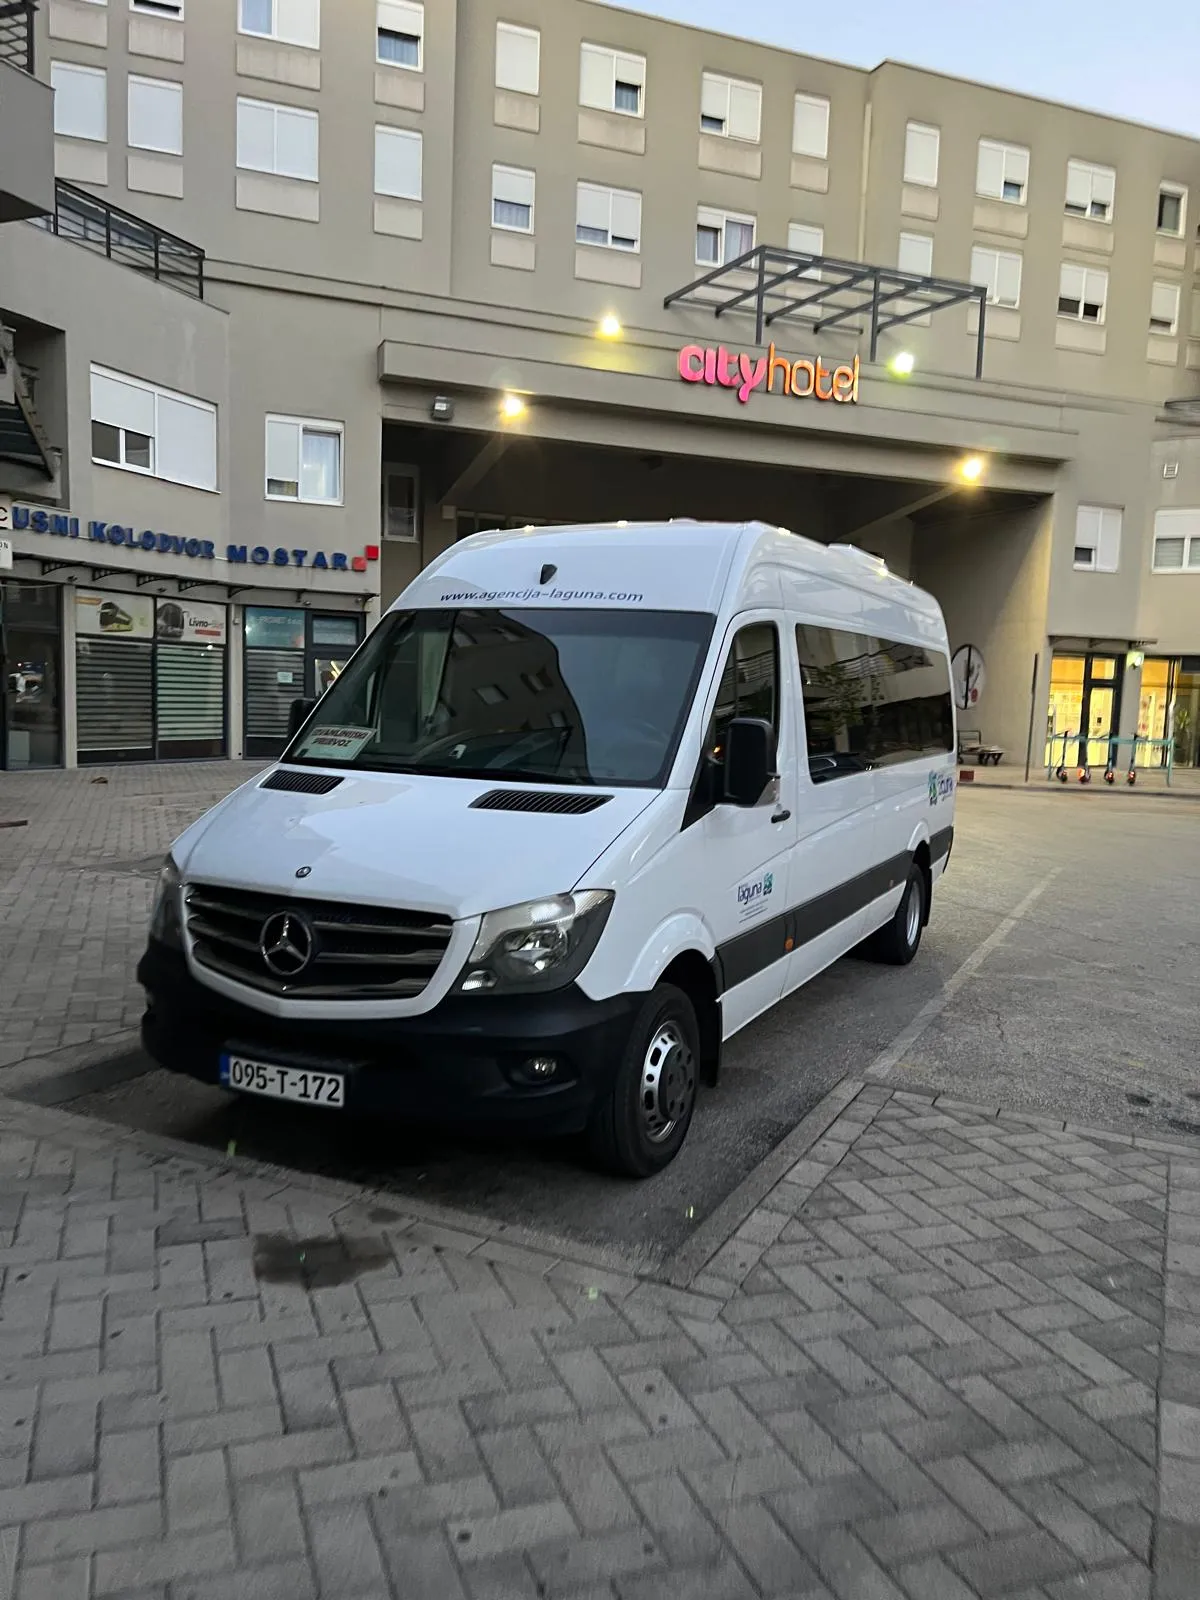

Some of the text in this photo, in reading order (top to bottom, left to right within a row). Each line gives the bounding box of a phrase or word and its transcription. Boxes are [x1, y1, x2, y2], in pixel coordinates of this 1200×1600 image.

[12, 506, 79, 538] USNI
[88, 521, 215, 559] KOLODVOR
[226, 544, 348, 571] MOSTAR
[440, 588, 644, 603] www.agencija-laguna.com
[737, 882, 762, 905] laguna
[232, 1061, 340, 1103] 095-T-172
